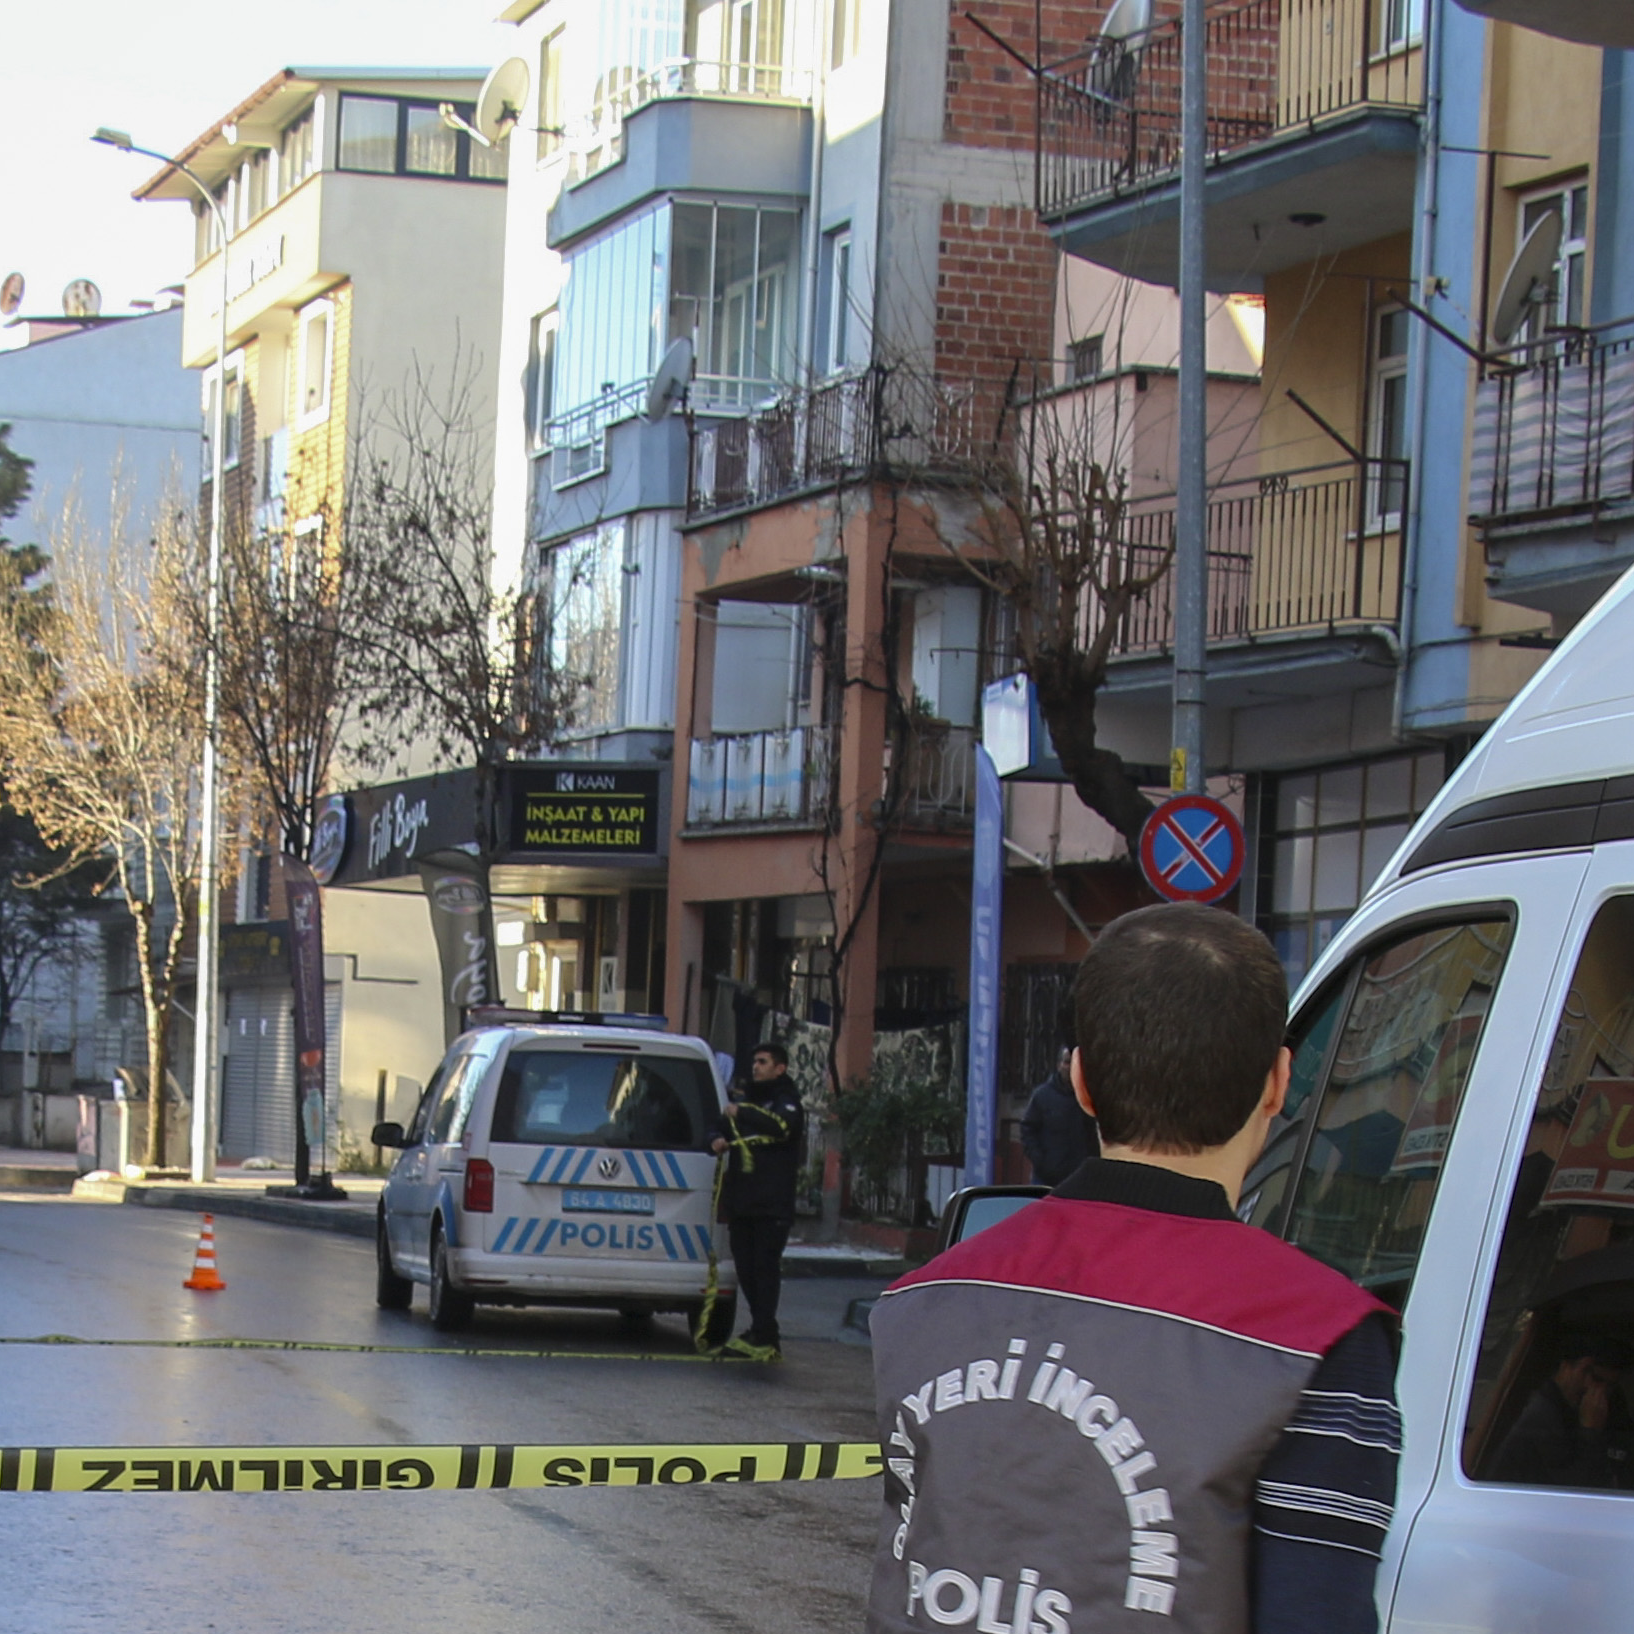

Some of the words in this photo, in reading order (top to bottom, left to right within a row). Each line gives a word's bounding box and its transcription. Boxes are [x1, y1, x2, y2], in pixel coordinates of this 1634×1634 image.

[577, 775, 615, 790] KAAN
[526, 803, 587, 825] İNŞAAT
[591, 806, 603, 822] &
[608, 806, 645, 822] YAPI
[368, 799, 393, 869] Filli
[394, 792, 430, 858] Boya
[525, 826, 640, 845] MALZEMELERİ
[596, 1192, 606, 1207] A
[560, 1221, 654, 1250] POLİS
[901, 1337, 1028, 1425] YERİ
[1027, 1342, 1180, 1617] İNCELEME
